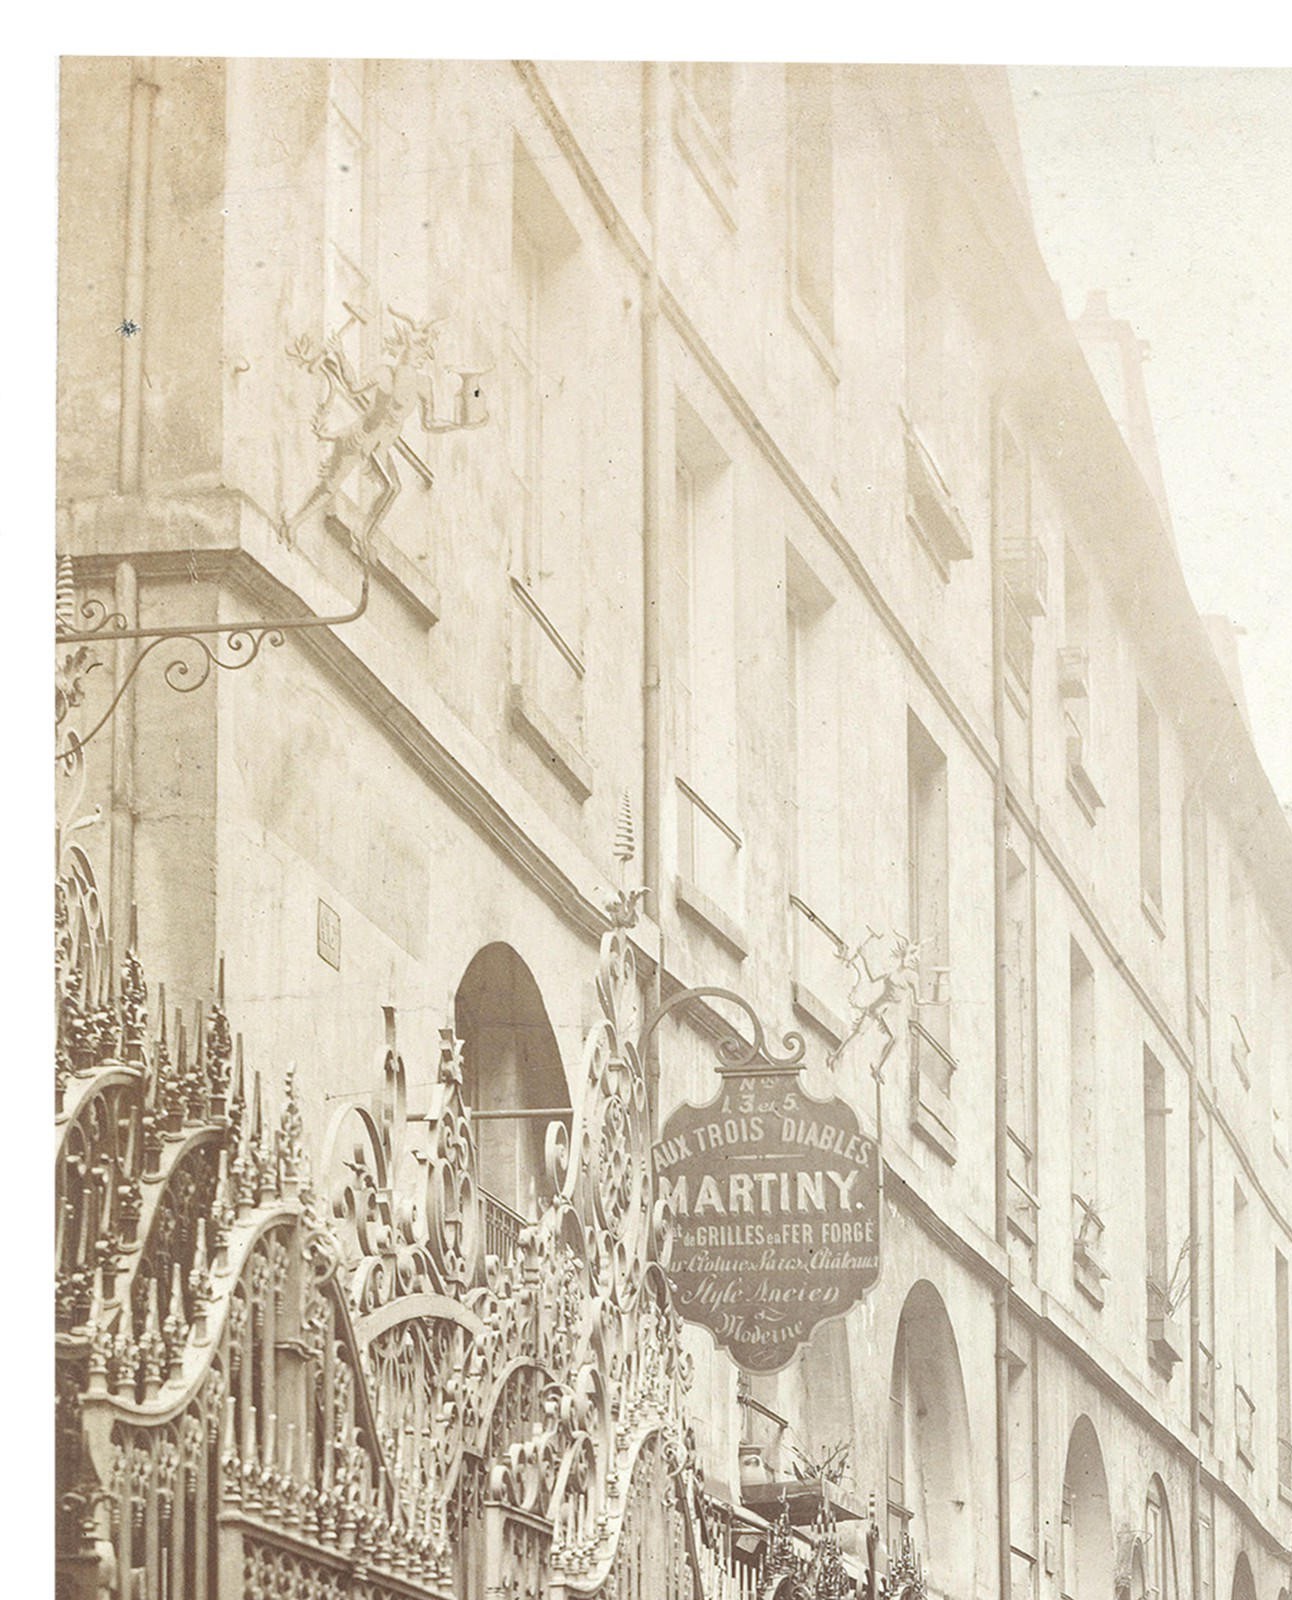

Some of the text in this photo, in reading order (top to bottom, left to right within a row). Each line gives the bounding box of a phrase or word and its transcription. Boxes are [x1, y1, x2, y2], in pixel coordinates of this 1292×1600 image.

[652, 1135, 692, 1173] AUX
[693, 1116, 765, 1151] TROIS
[697, 1225, 765, 1246] GRILLES
[782, 1223, 813, 1244] FER
[746, 1278, 840, 1303] Ancien
[715, 1312, 804, 1344] Moderne
